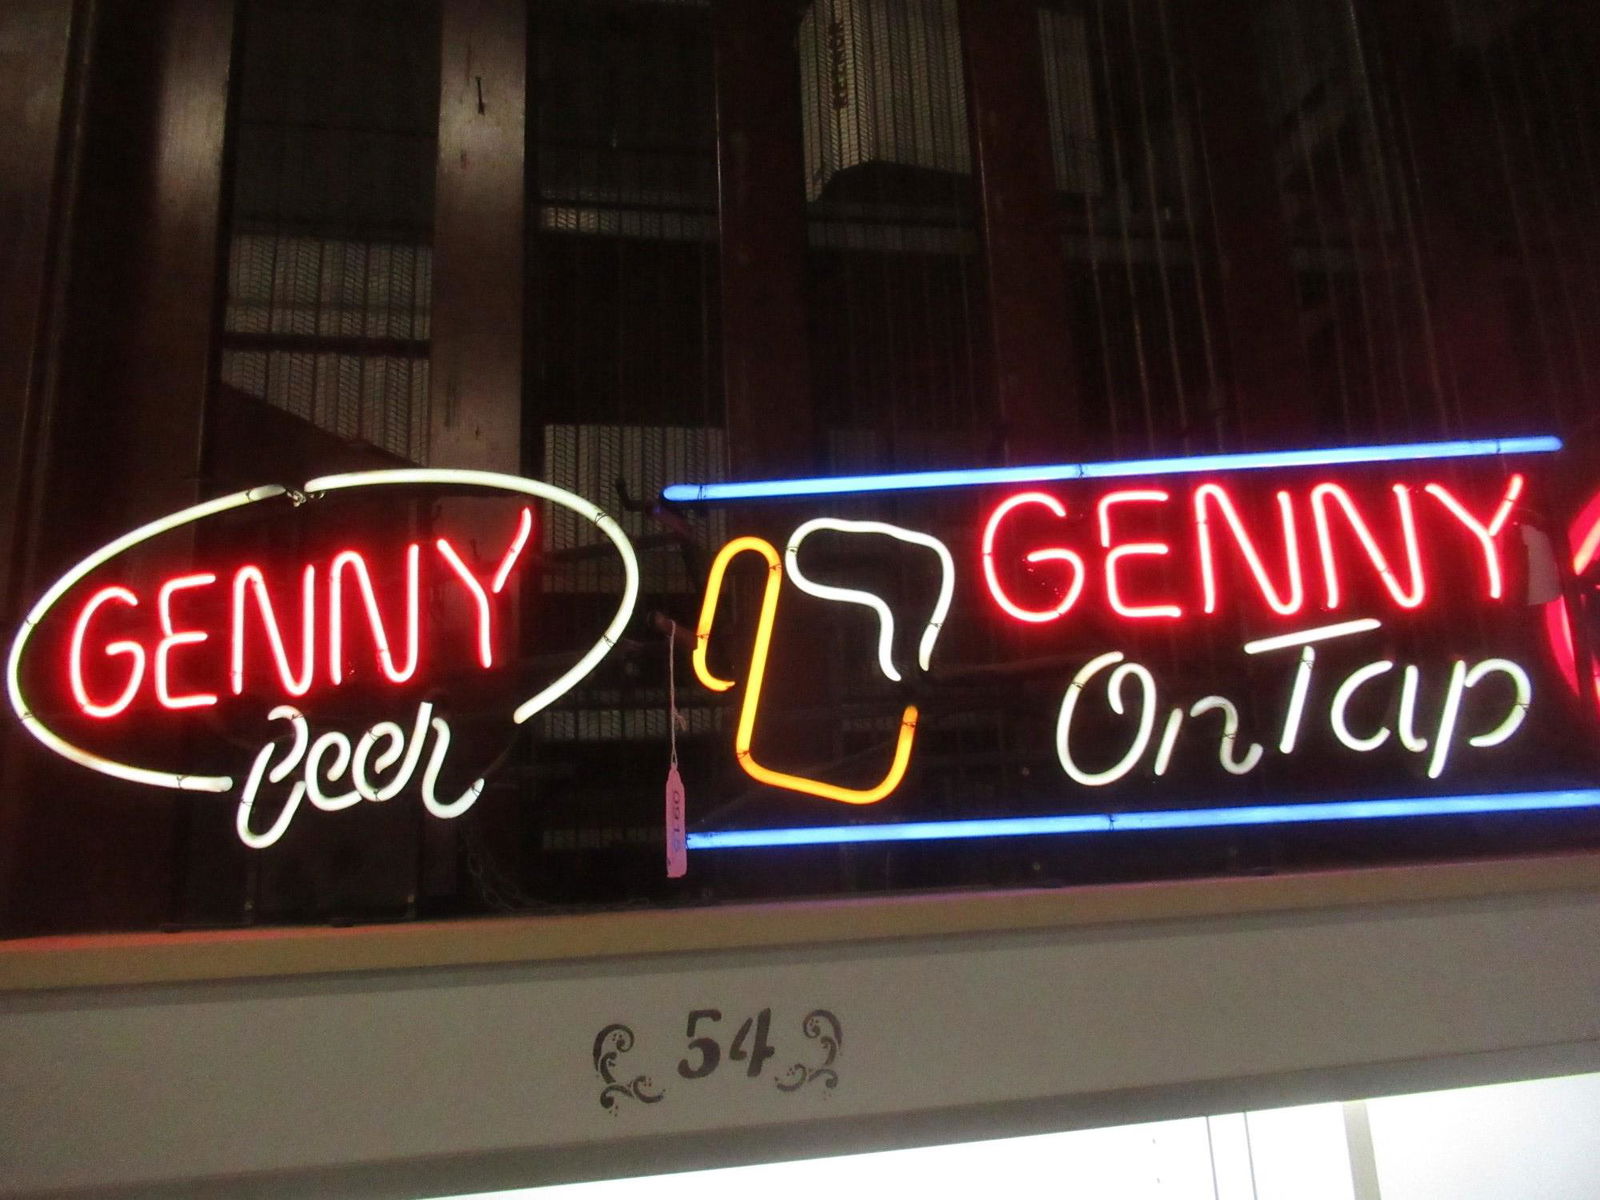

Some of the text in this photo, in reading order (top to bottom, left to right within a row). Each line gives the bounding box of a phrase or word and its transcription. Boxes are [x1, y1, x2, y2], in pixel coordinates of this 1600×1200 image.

[68, 505, 533, 719] GENNY
[981, 473, 1524, 624] GENNY
[236, 701, 486, 849] Beer
[1055, 617, 1533, 787] On Tap
[677, 1006, 776, 1080] 54
